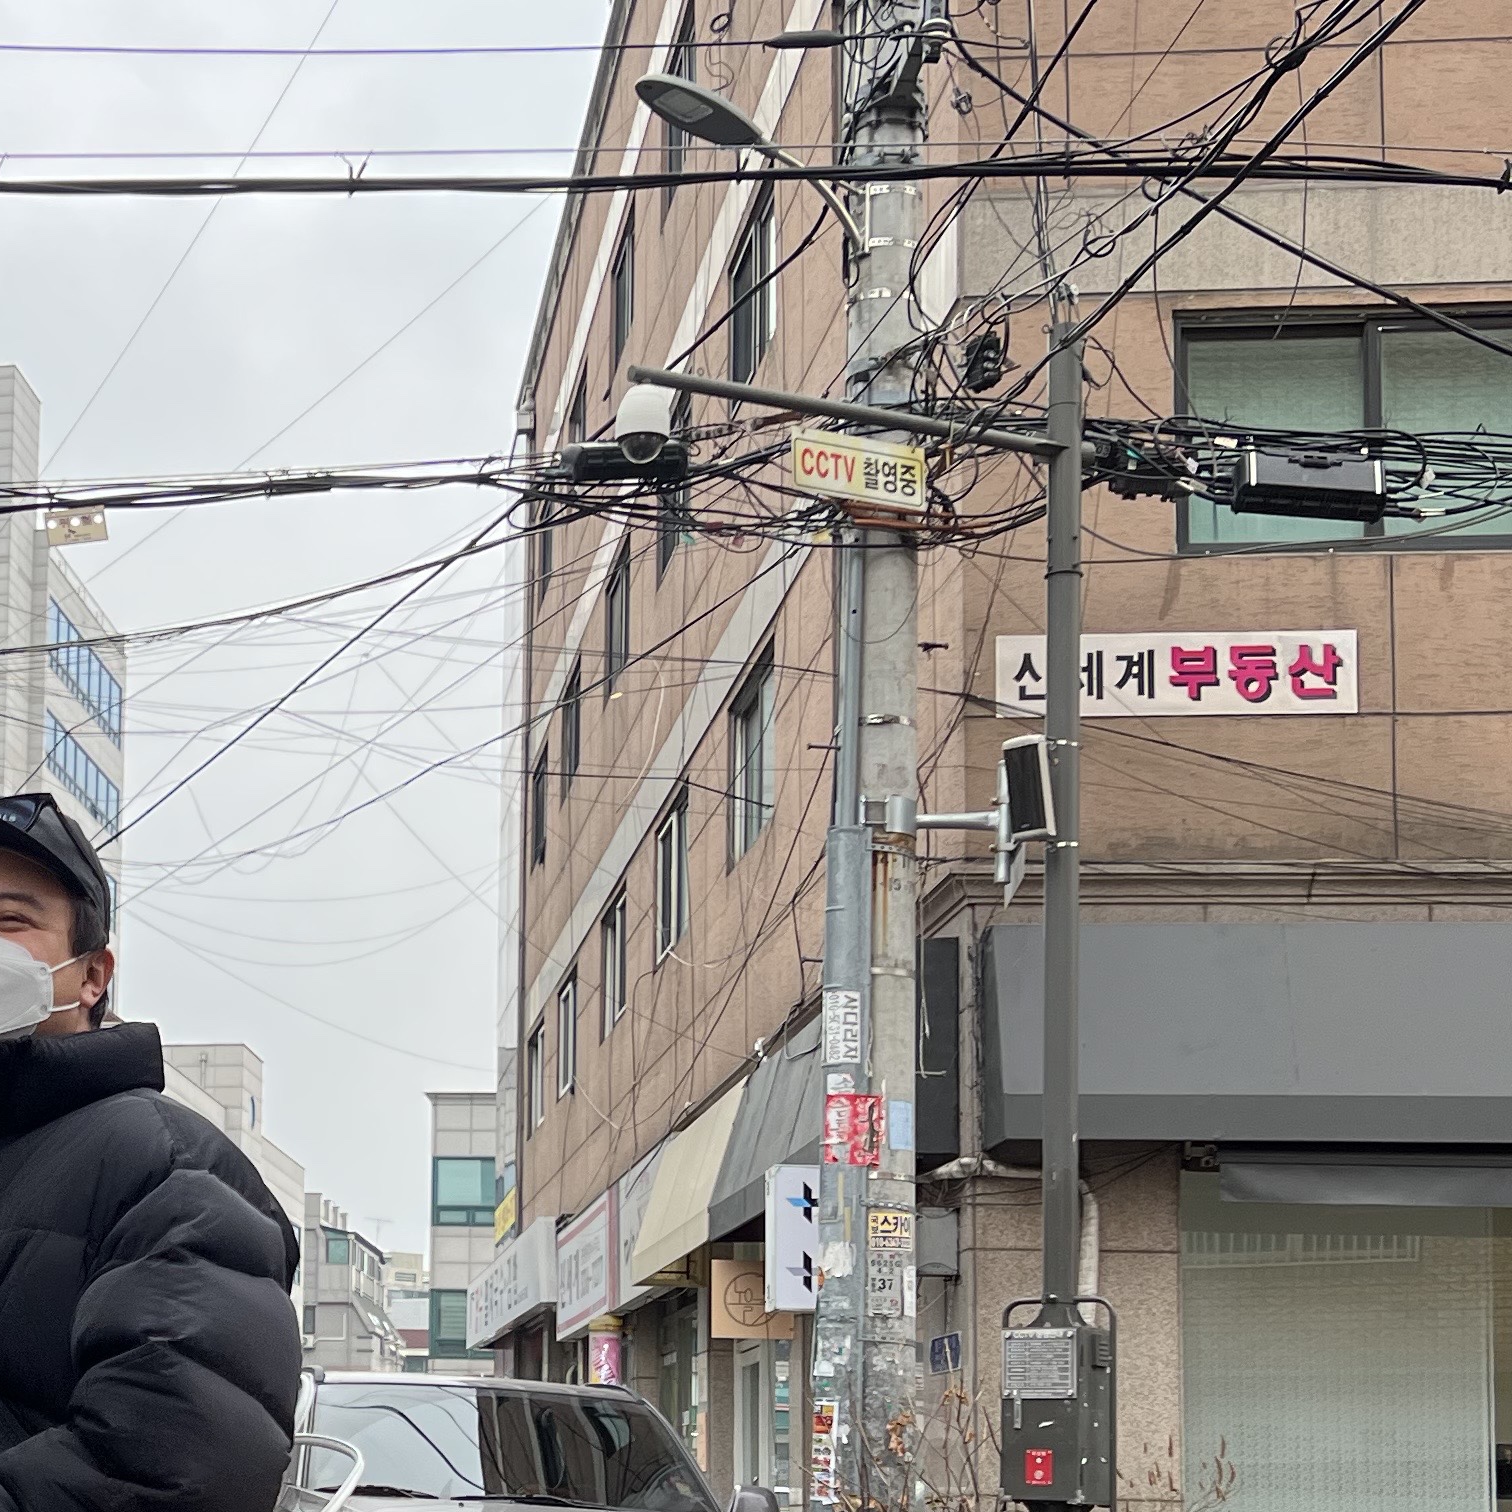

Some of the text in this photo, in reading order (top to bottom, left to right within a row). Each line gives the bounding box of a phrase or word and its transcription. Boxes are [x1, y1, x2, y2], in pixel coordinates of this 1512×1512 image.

[801, 447, 856, 484] CCTV
[1169, 643, 1344, 704] 부동산
[879, 1278, 894, 1290] 37
